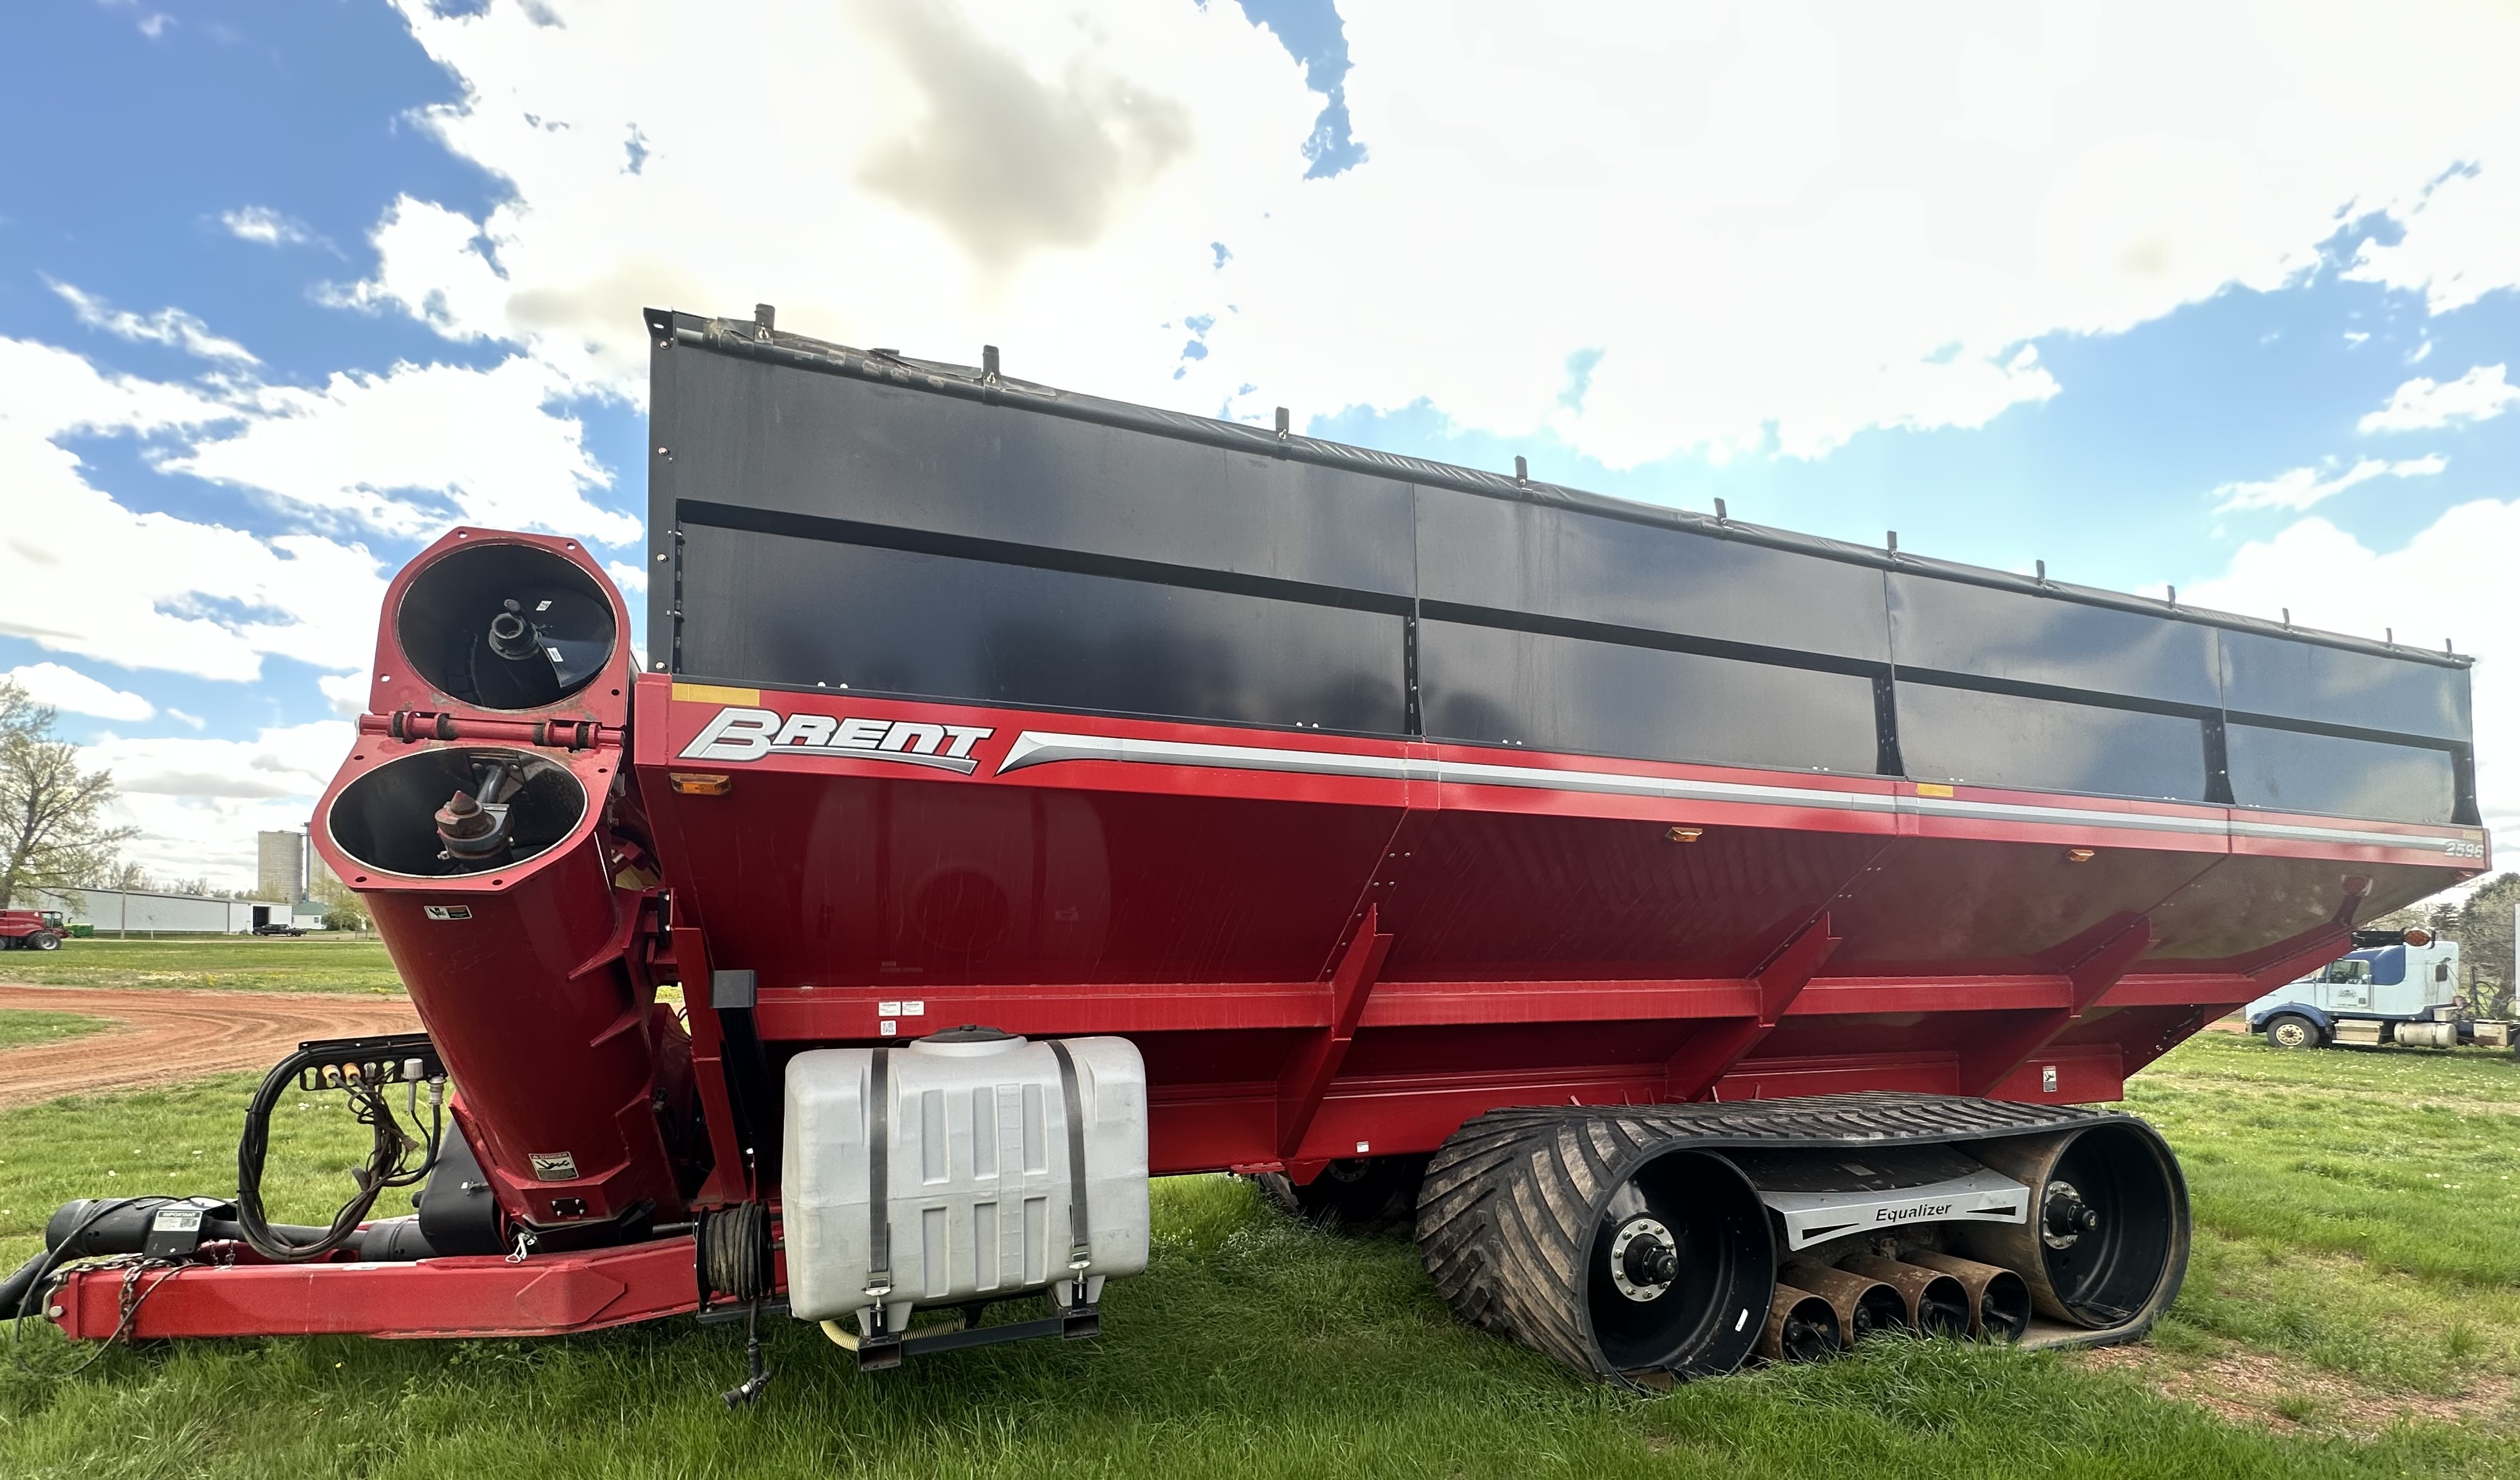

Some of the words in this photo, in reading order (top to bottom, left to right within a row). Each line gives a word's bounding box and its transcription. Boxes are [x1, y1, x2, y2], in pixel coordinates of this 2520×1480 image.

[678, 707, 995, 762] BRENT
[2444, 841, 2484, 858] 2596
[1876, 1204, 1952, 1222] Equalizer
